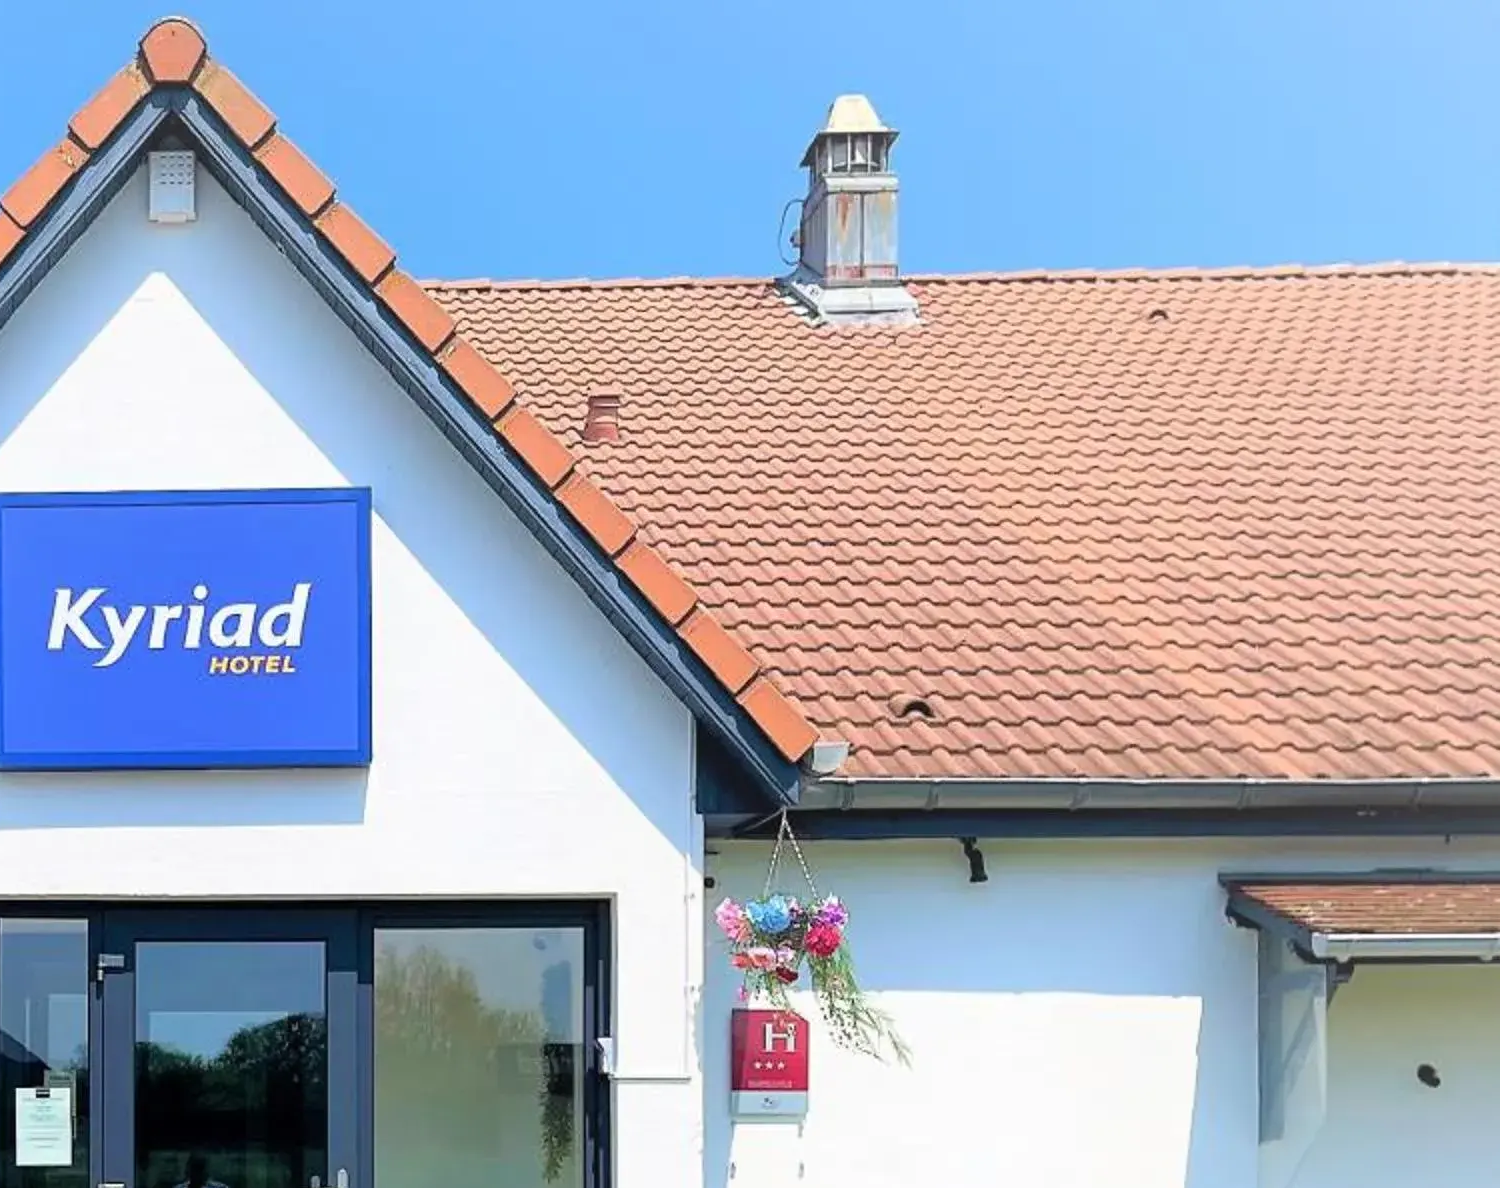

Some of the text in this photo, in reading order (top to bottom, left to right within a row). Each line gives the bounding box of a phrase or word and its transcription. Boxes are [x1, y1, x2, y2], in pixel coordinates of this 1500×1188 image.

[47, 582, 312, 668] Kyriad
[209, 655, 296, 674] HOTEL
[764, 1023, 796, 1053] H
